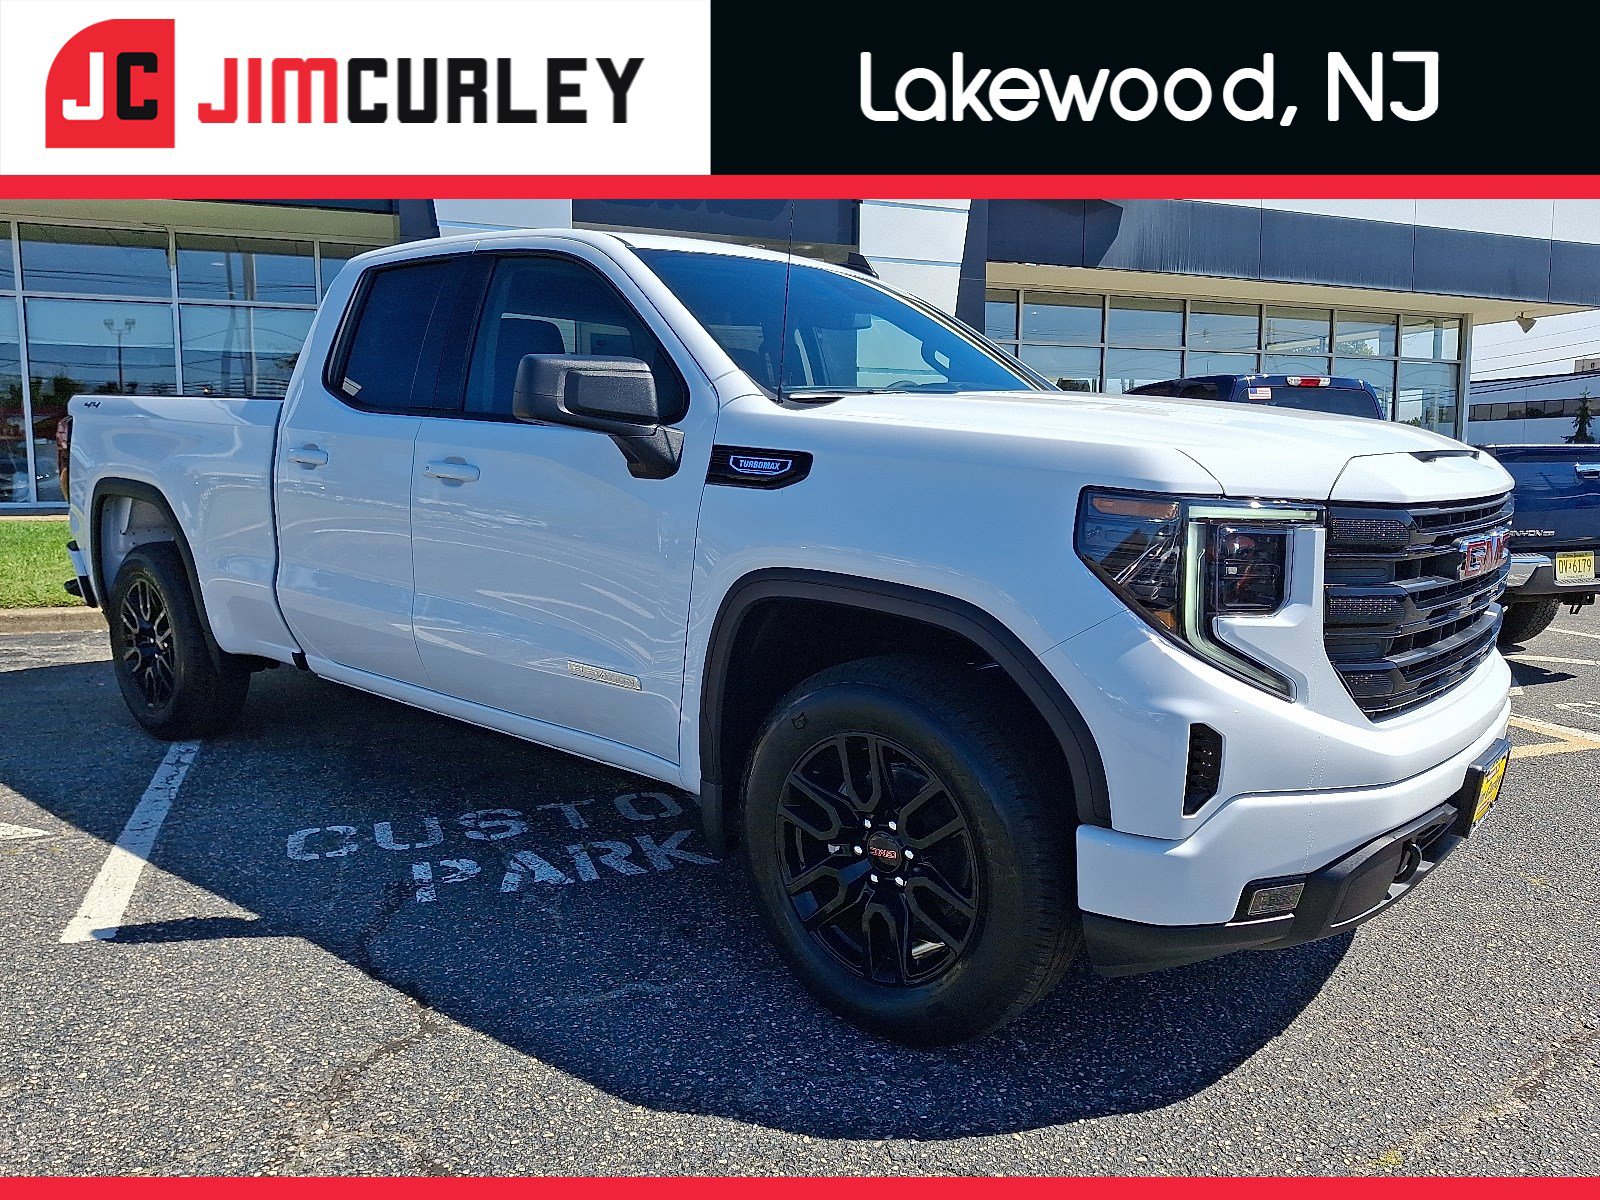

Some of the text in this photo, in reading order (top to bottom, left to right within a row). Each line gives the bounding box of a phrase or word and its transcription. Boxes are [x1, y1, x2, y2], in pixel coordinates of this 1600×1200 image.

[739, 459, 781, 471] TURBOMAX
[286, 791, 702, 862] CUSTO
[411, 798, 722, 902] PARK
